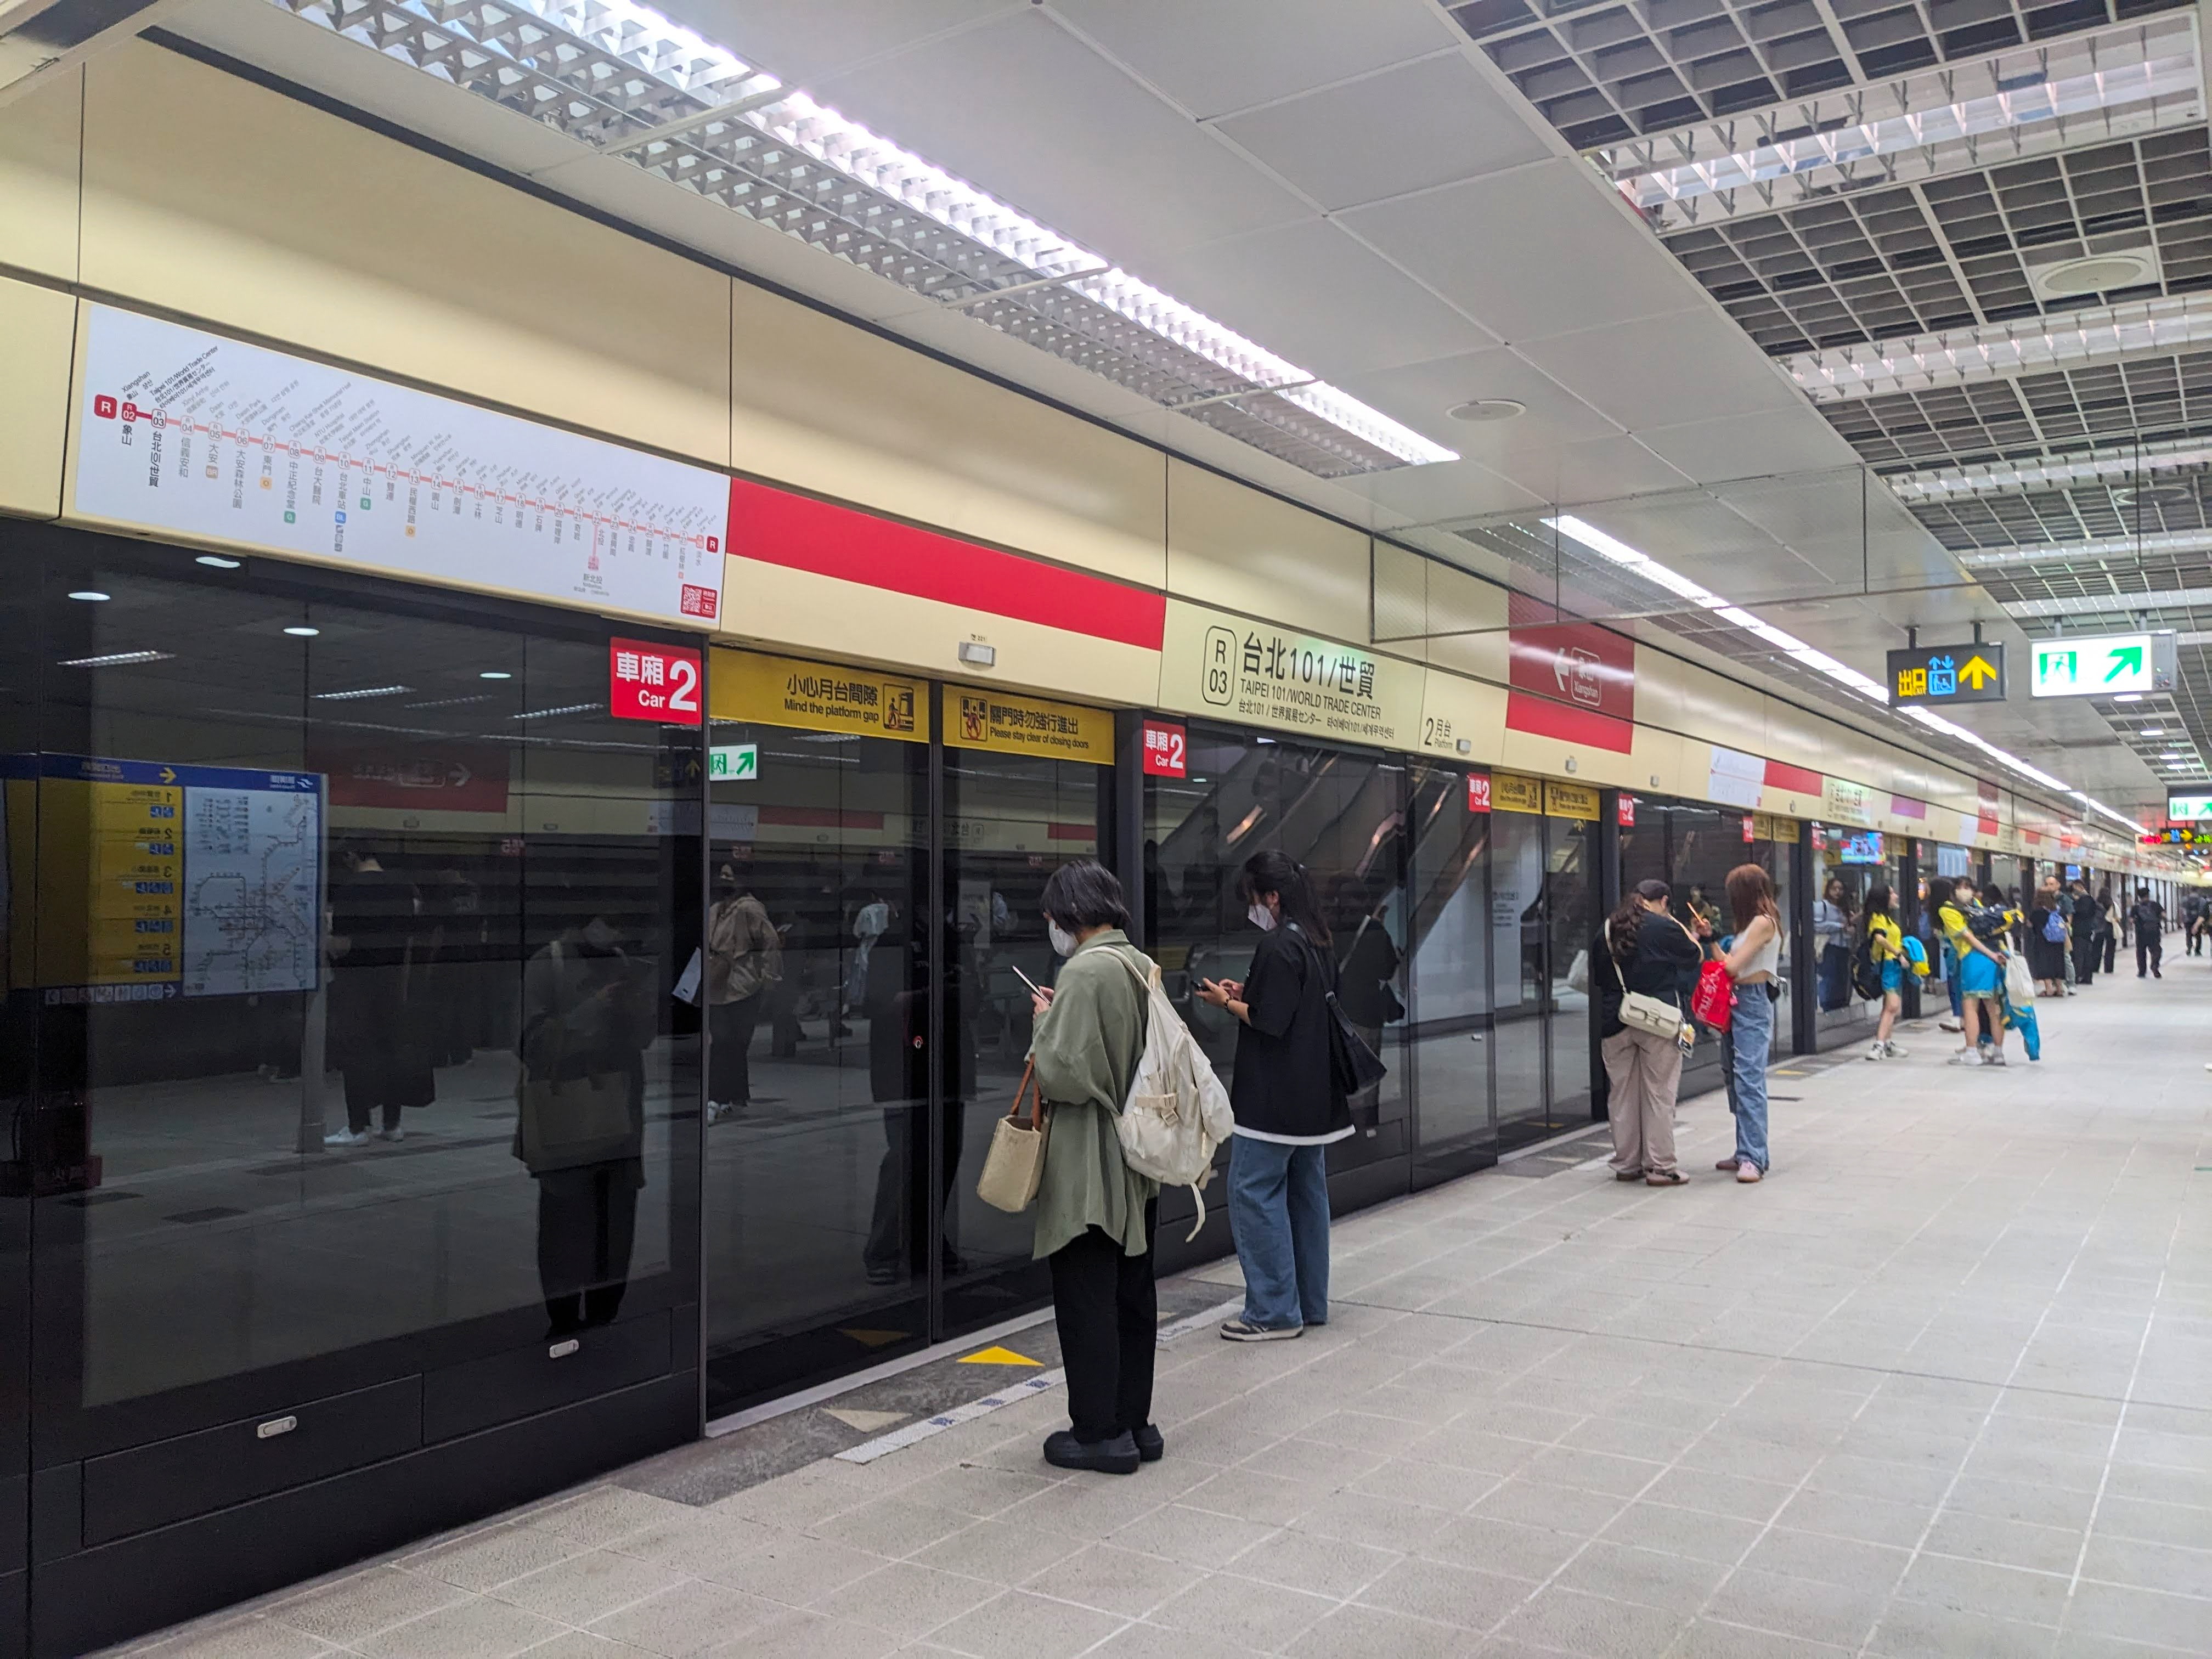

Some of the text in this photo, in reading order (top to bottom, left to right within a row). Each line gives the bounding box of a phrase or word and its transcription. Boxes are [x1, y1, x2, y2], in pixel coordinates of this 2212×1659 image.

[122, 371, 151, 393] Xiangshan
[150, 346, 218, 396] Taipei 101/World Trade Center
[101, 401, 111, 413] R
[123, 411, 134, 420] 02
[153, 417, 164, 426] 03
[182, 424, 193, 432] 04
[122, 424, 132, 445] 象山
[210, 430, 221, 439] 05
[237, 436, 247, 444] 06
[208, 443, 219, 464] 大安
[363, 477, 371, 496] 中山
[1216, 639, 1226, 664] R
[616, 652, 665, 686] 車廂
[1243, 631, 1376, 699] 台北101/世貿
[668, 660, 698, 712] 2
[786, 673, 879, 707] 小心月台間隙
[1209, 668, 1228, 694] 03
[1898, 668, 1927, 697] 出口
[638, 689, 665, 709] Car
[1240, 678, 1381, 720] TAIPEI 101/WORLD TRADE CENTER
[784, 698, 879, 724] Mind the platform gap
[989, 704, 1079, 735] 關門時勿強行進出
[990, 727, 1089, 749] Please stay clear of closing doors
[1424, 718, 1435, 747] 2
[1435, 718, 1452, 738] 月台
[1145, 729, 1169, 752] 車廂
[1169, 733, 1184, 769] 2
[1434, 738, 1453, 751] Platform
[1155, 754, 1169, 768] Car
[1482, 782, 1490, 806] 2
[1627, 800, 1634, 820] 2
